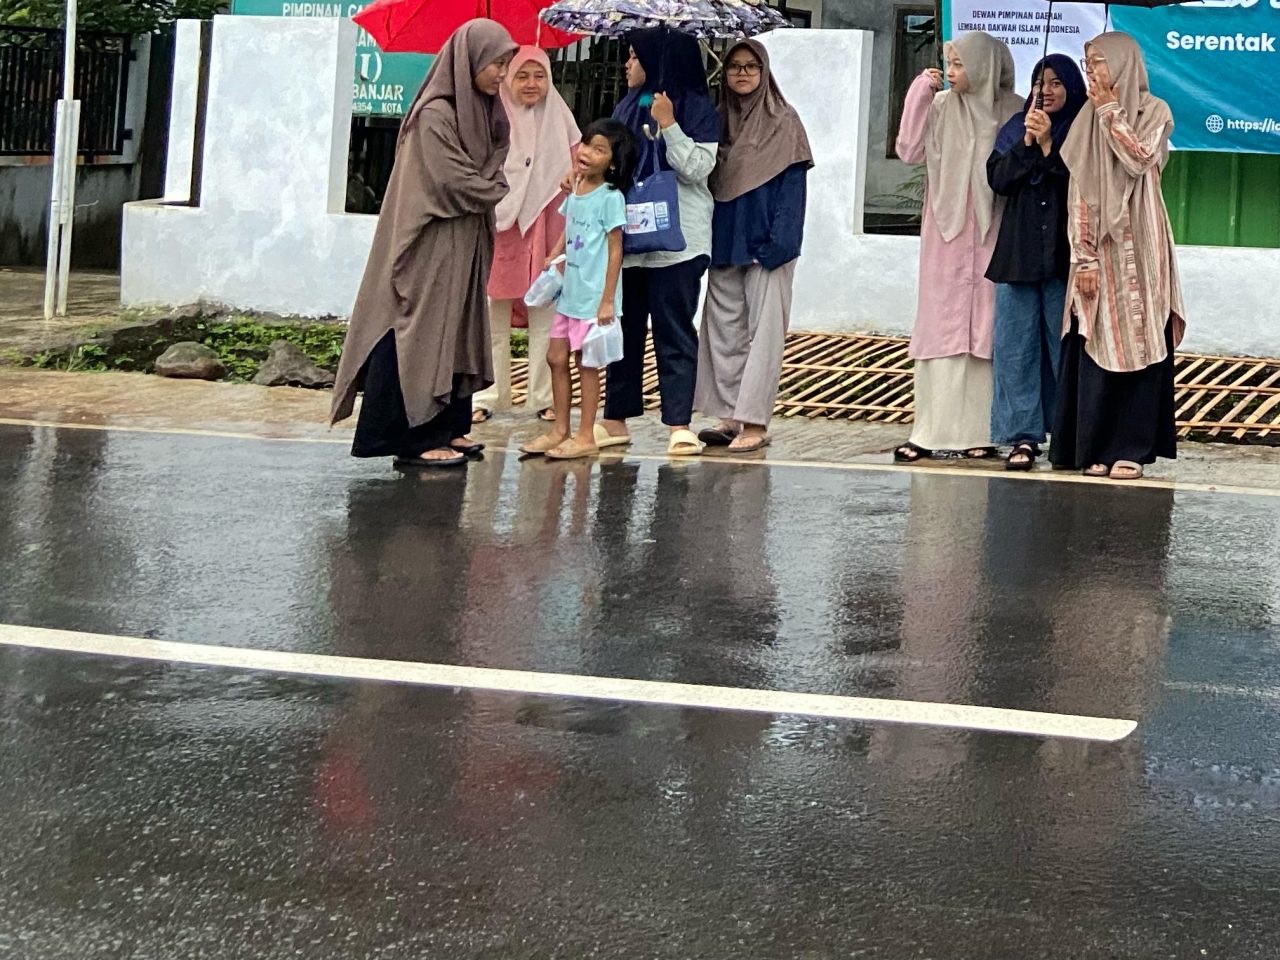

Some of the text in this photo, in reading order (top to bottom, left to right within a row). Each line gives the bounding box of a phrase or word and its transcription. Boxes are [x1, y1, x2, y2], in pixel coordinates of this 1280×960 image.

[282, 3, 341, 17] PIMPINAN
[972, 10, 996, 19] DEWAN
[997, 11, 1033, 20] PIMPINAN
[958, 23, 986, 32] LEMBAGA
[988, 23, 1017, 32] DAKWAH
[1018, 24, 1041, 33] ISLAM
[1011, 37, 1039, 45] BANJAR
[1166, 31, 1275, 53] Serentak
[352, 84, 404, 100] BANJAR
[381, 102, 402, 113] KOTA
